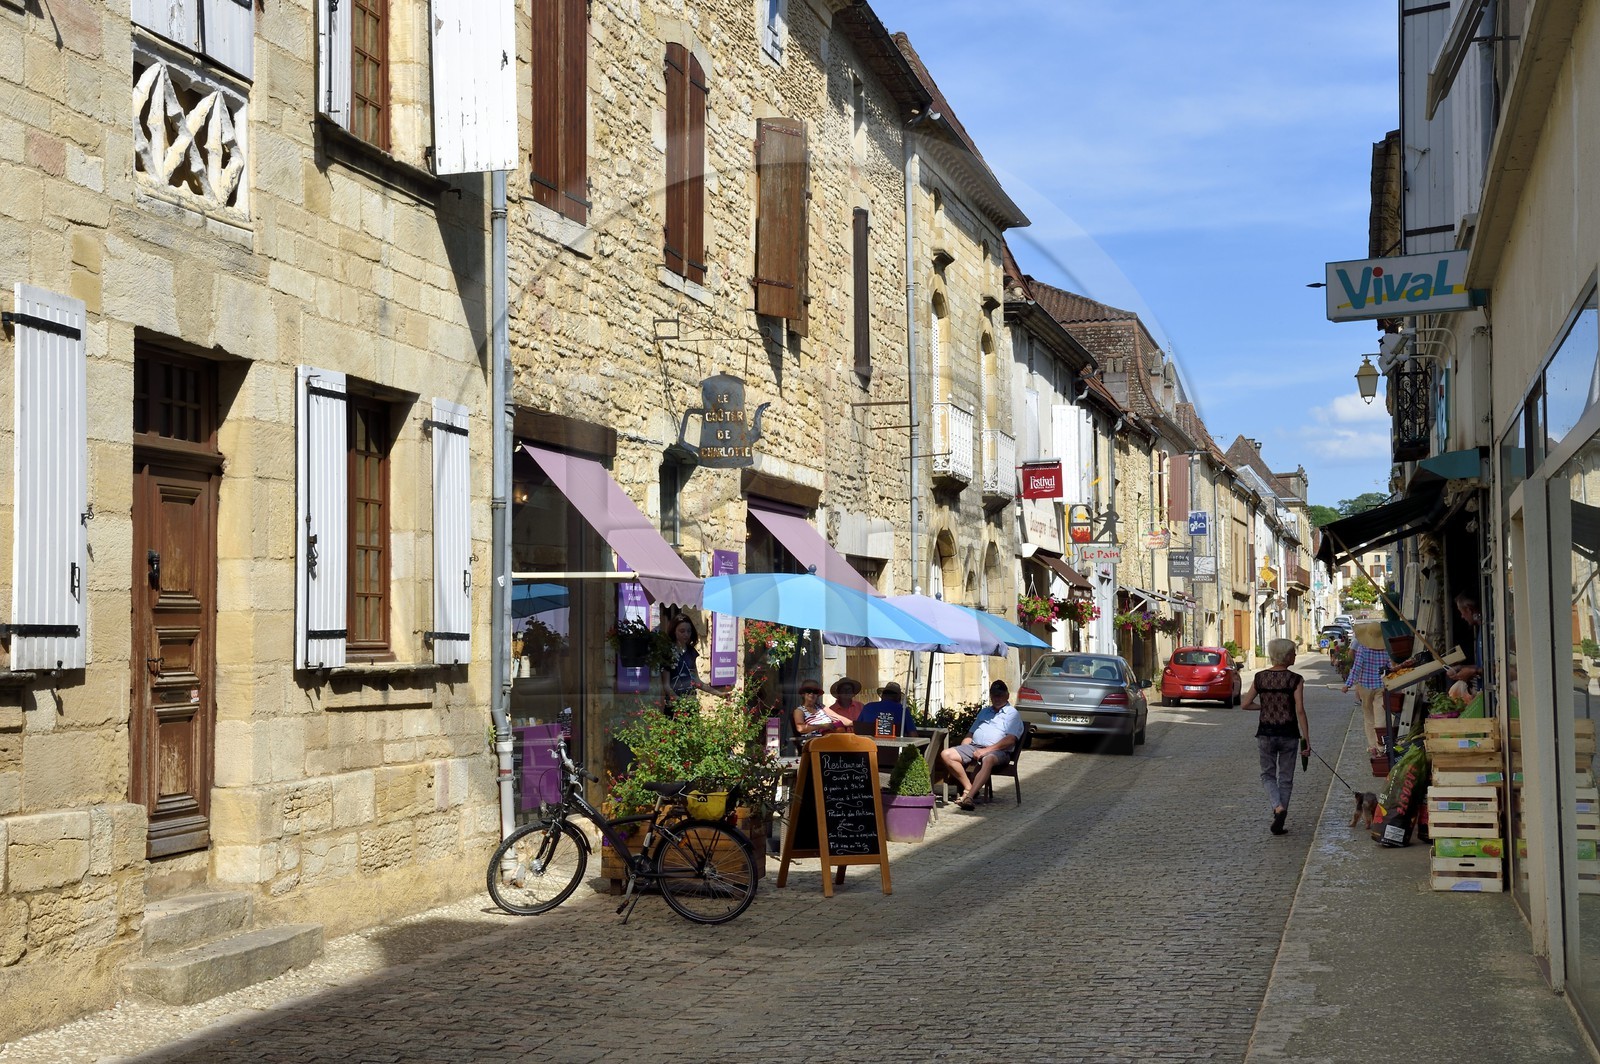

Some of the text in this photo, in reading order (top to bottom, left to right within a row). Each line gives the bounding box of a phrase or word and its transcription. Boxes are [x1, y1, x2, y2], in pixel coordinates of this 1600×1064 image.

[717, 394, 728, 403] LE
[716, 430, 731, 440] DE
[700, 446, 751, 459] CHARLOTTE
[1030, 475, 1056, 490] Festival
[1084, 549, 1119, 559] Le Pain
[822, 754, 866, 770] Restaurant
